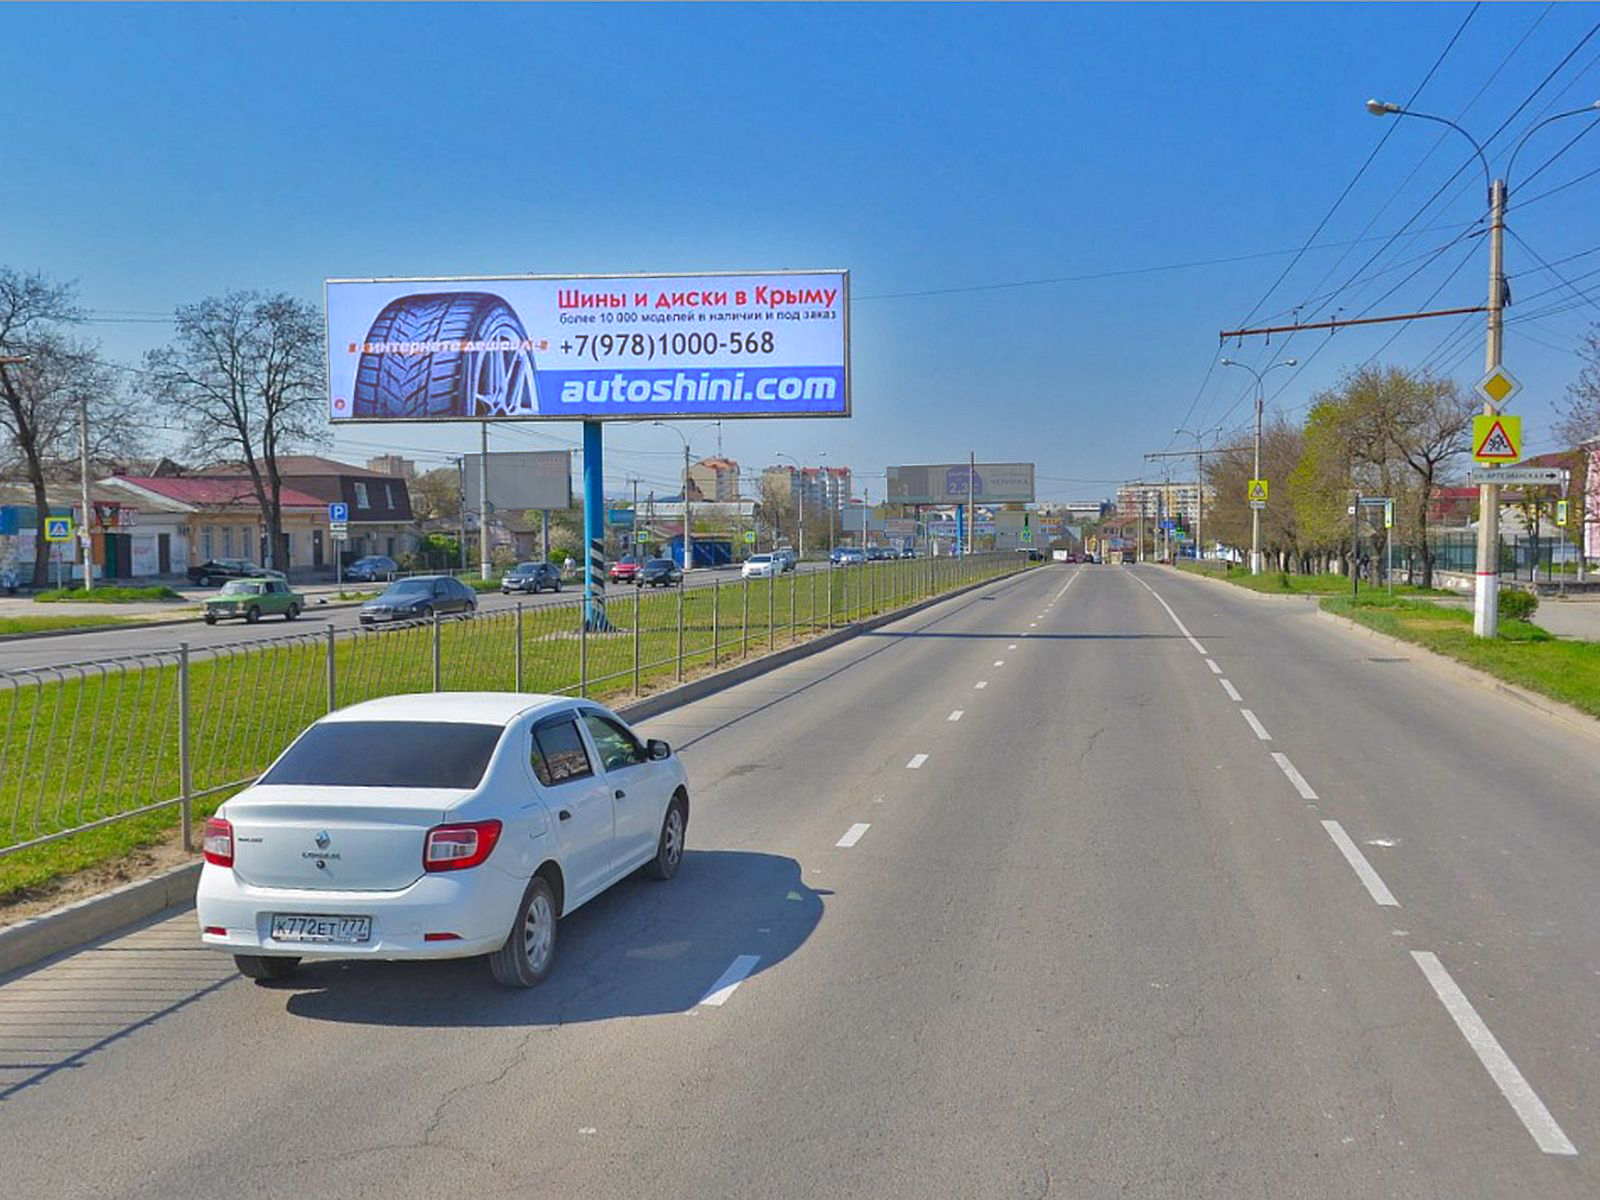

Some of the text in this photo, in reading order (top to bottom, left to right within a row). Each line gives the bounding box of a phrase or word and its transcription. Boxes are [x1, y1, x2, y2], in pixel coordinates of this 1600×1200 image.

[558, 286, 837, 310] Шины и диски в Крыму
[559, 312, 596, 325] более
[642, 310, 694, 324] моделей
[709, 311, 762, 321] наличии
[777, 310, 801, 320] под
[804, 309, 837, 320] заказ
[560, 331, 775, 361] +7(978)1000-568
[561, 371, 837, 403] autoshini.com
